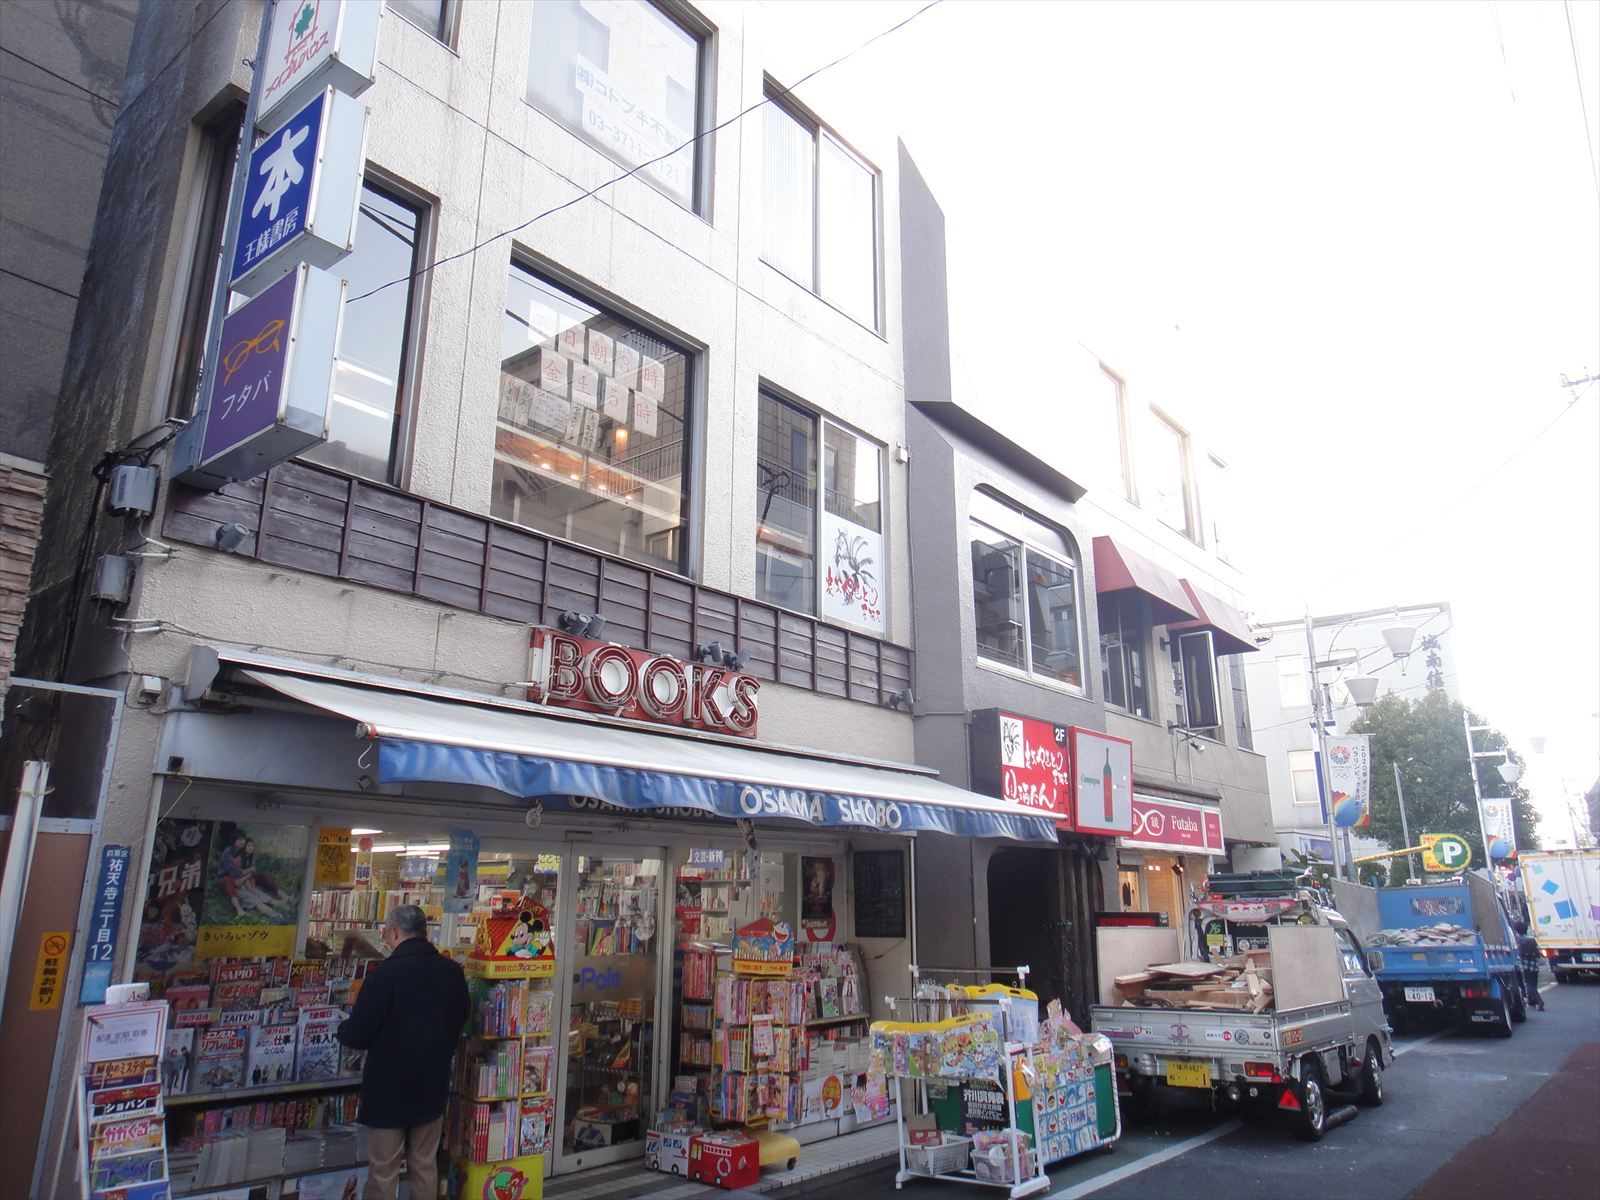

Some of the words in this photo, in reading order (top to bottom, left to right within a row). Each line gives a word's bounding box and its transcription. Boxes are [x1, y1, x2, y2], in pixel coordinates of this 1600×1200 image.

[252, 125, 309, 222] 本
[243, 205, 299, 267] 王様書房
[221, 370, 272, 421] フタバ
[542, 633, 761, 732] BOOKS
[1055, 728, 1065, 743] 2F
[738, 785, 825, 822] OSAMA
[839, 790, 903, 829] SHOBO
[1171, 815, 1199, 833] Futaba
[1442, 842, 1463, 865] P
[145, 861, 202, 903] 兄弟
[96, 858, 124, 943] 祐天寺二丁目
[203, 930, 269, 944] きいろいゾウ
[91, 945, 113, 961] 12
[221, 969, 253, 981] SAPIO
[223, 1013, 255, 1023] ZAITEN
[206, 1030, 236, 1040] エコノミスト
[201, 1037, 245, 1052] リフレの正体
[96, 1059, 153, 1078] 歴史のミステリー
[105, 1099, 147, 1114] ショパン
